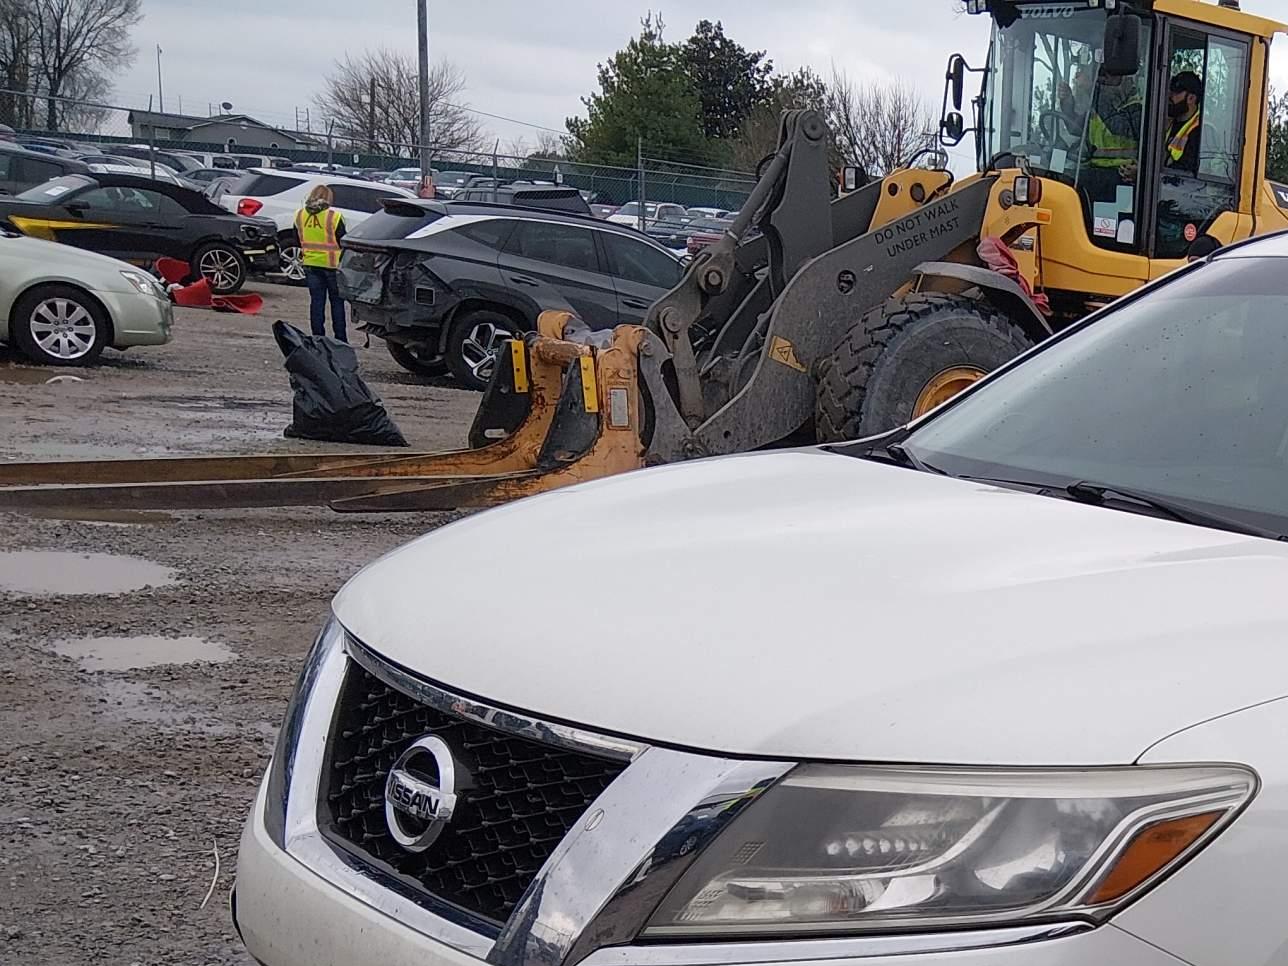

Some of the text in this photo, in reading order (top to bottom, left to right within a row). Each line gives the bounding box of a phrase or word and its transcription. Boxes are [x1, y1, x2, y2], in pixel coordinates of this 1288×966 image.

[875, 199, 960, 245] DO NOT WALK
[886, 217, 960, 257] UNDER MAST
